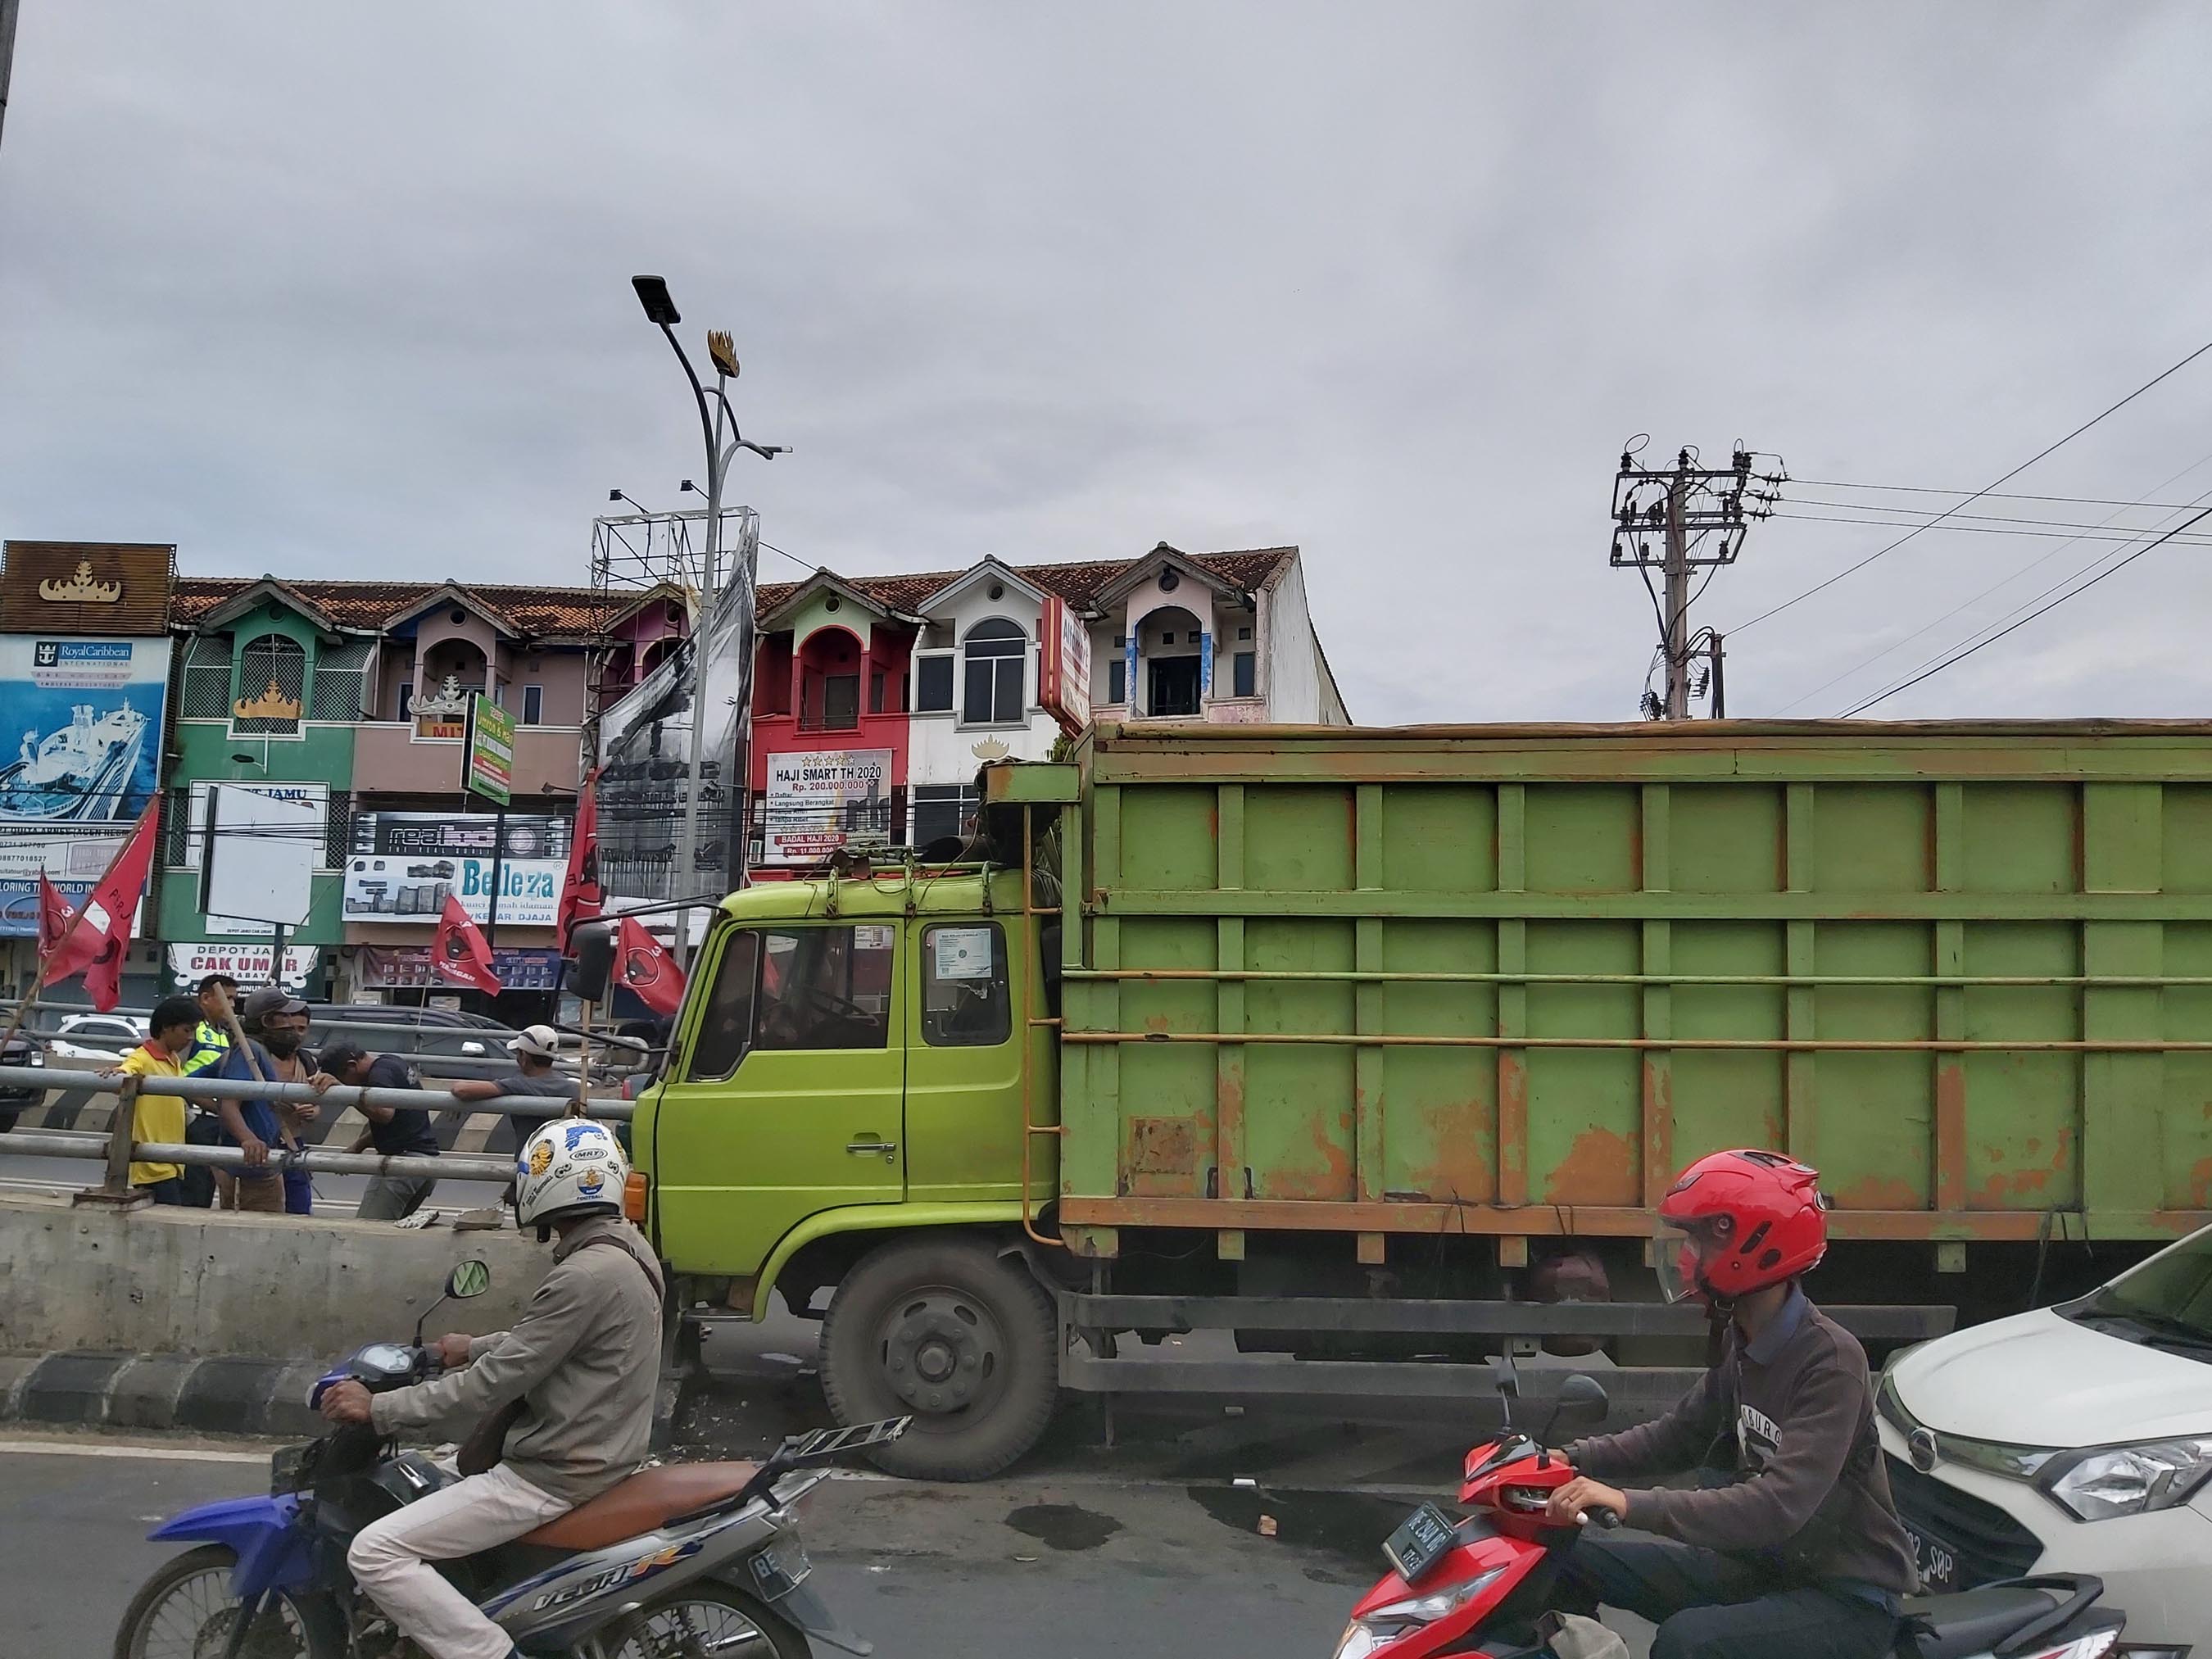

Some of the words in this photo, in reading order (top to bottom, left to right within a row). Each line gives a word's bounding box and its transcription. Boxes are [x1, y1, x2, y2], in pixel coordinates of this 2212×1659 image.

[776, 768, 800, 782] HAJI
[803, 768, 838, 781] SMART
[841, 767, 854, 779] TH
[857, 766, 882, 779] 2020
[792, 782, 807, 793] Rp.
[809, 781, 864, 791] 200.000.000
[805, 799, 834, 807] Berangkat
[782, 835, 805, 843] BADAL
[823, 834, 840, 842] 2020
[518, 913, 552, 921] DJAJA
[197, 945, 248, 955] DEPOT
[190, 956, 232, 971] CAK
